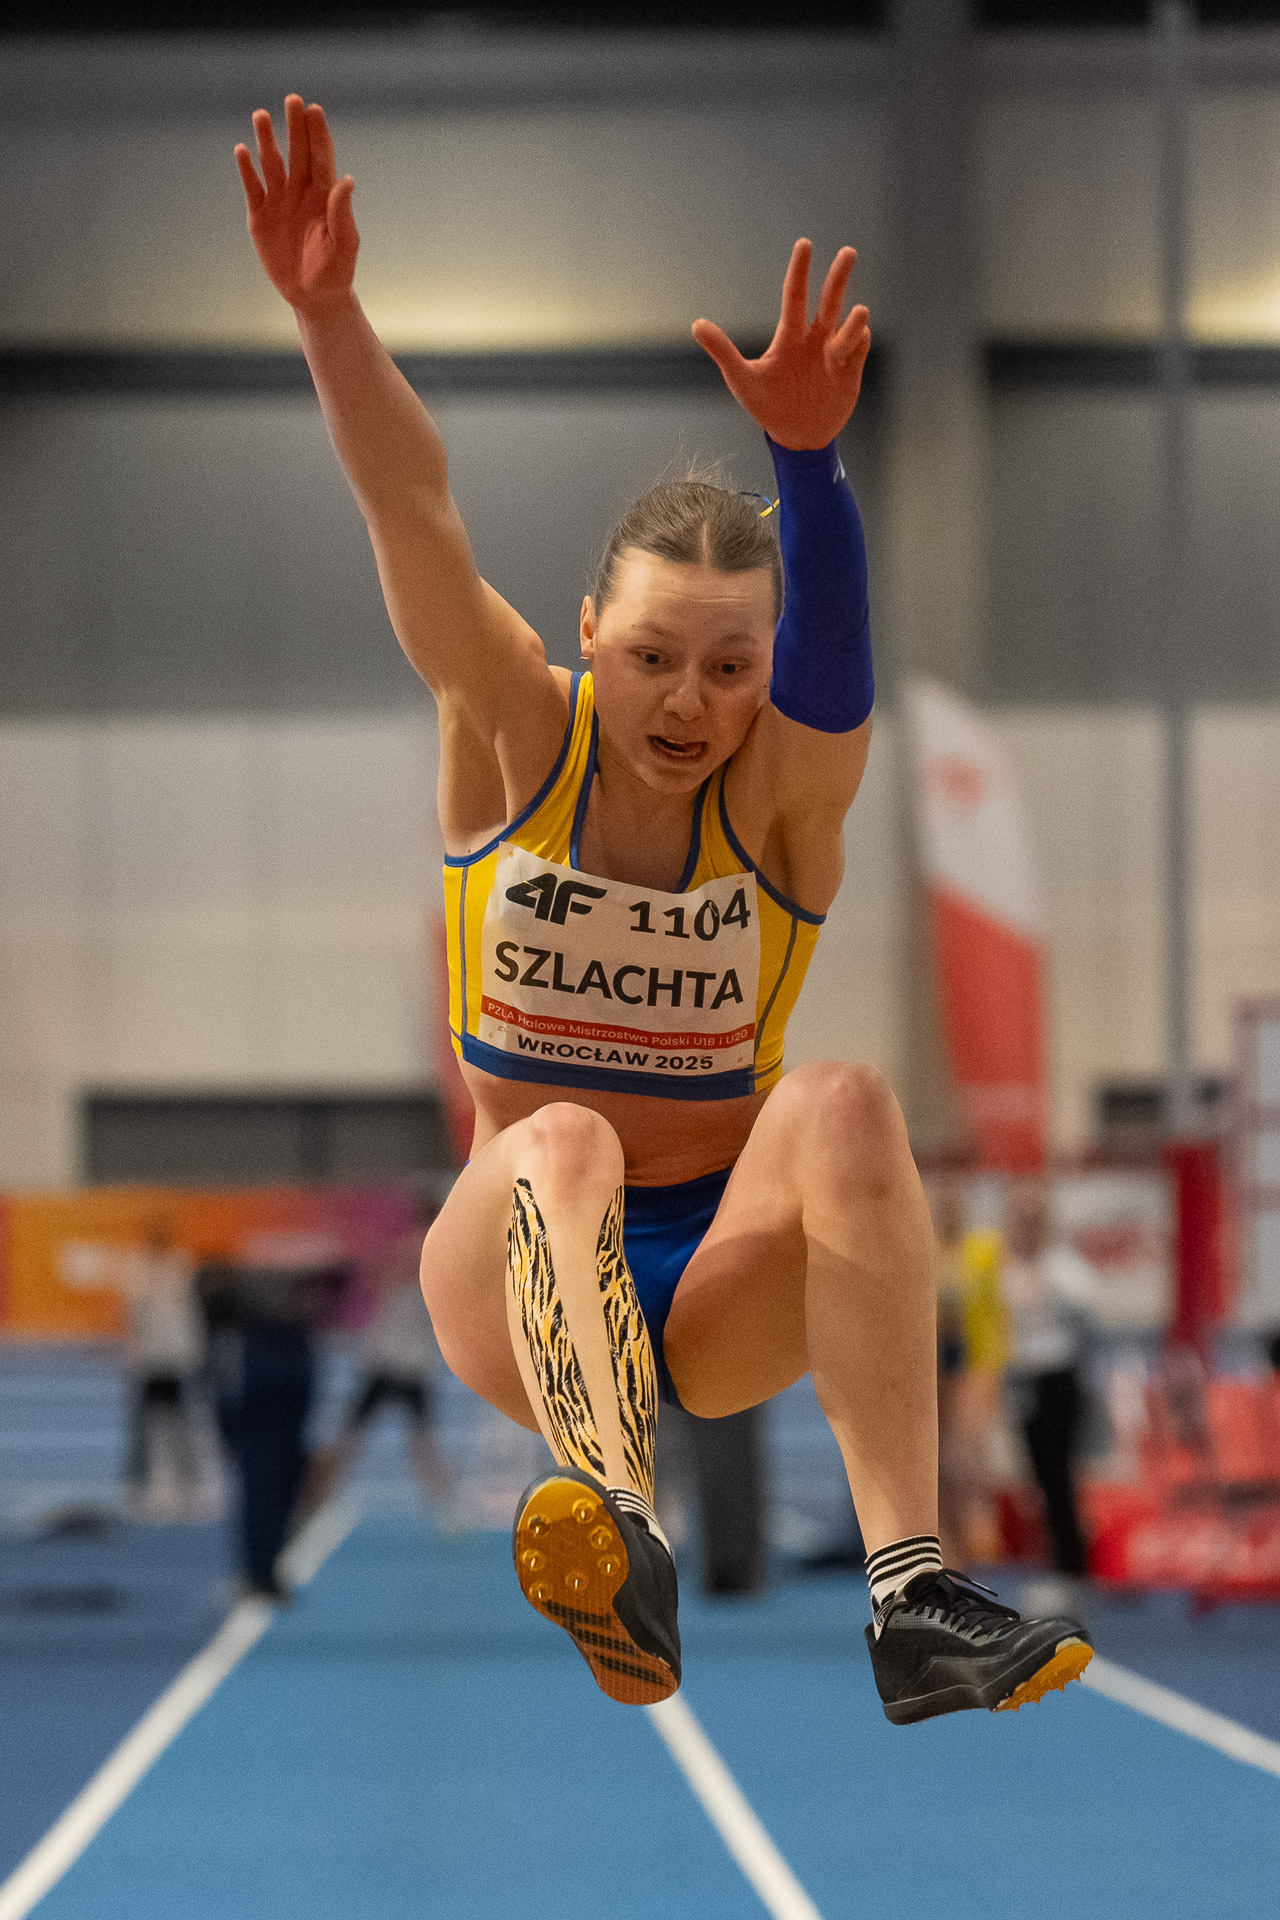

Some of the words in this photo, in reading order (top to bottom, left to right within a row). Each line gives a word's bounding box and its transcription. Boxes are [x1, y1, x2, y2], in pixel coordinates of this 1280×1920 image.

[505, 872, 607, 925] 4F
[628, 887, 750, 941] 1104
[494, 941, 744, 1009] SZLACHTA
[488, 1002, 515, 1019] PZLA
[518, 1014, 566, 1031] Halowe
[569, 1024, 648, 1043] Mistrzostwa
[652, 1036, 689, 1046] Polski
[693, 1037, 714, 1046] U18
[726, 1029, 747, 1043] U20
[518, 1034, 649, 1066] WROCŁAW
[655, 1055, 713, 1070] 2025
